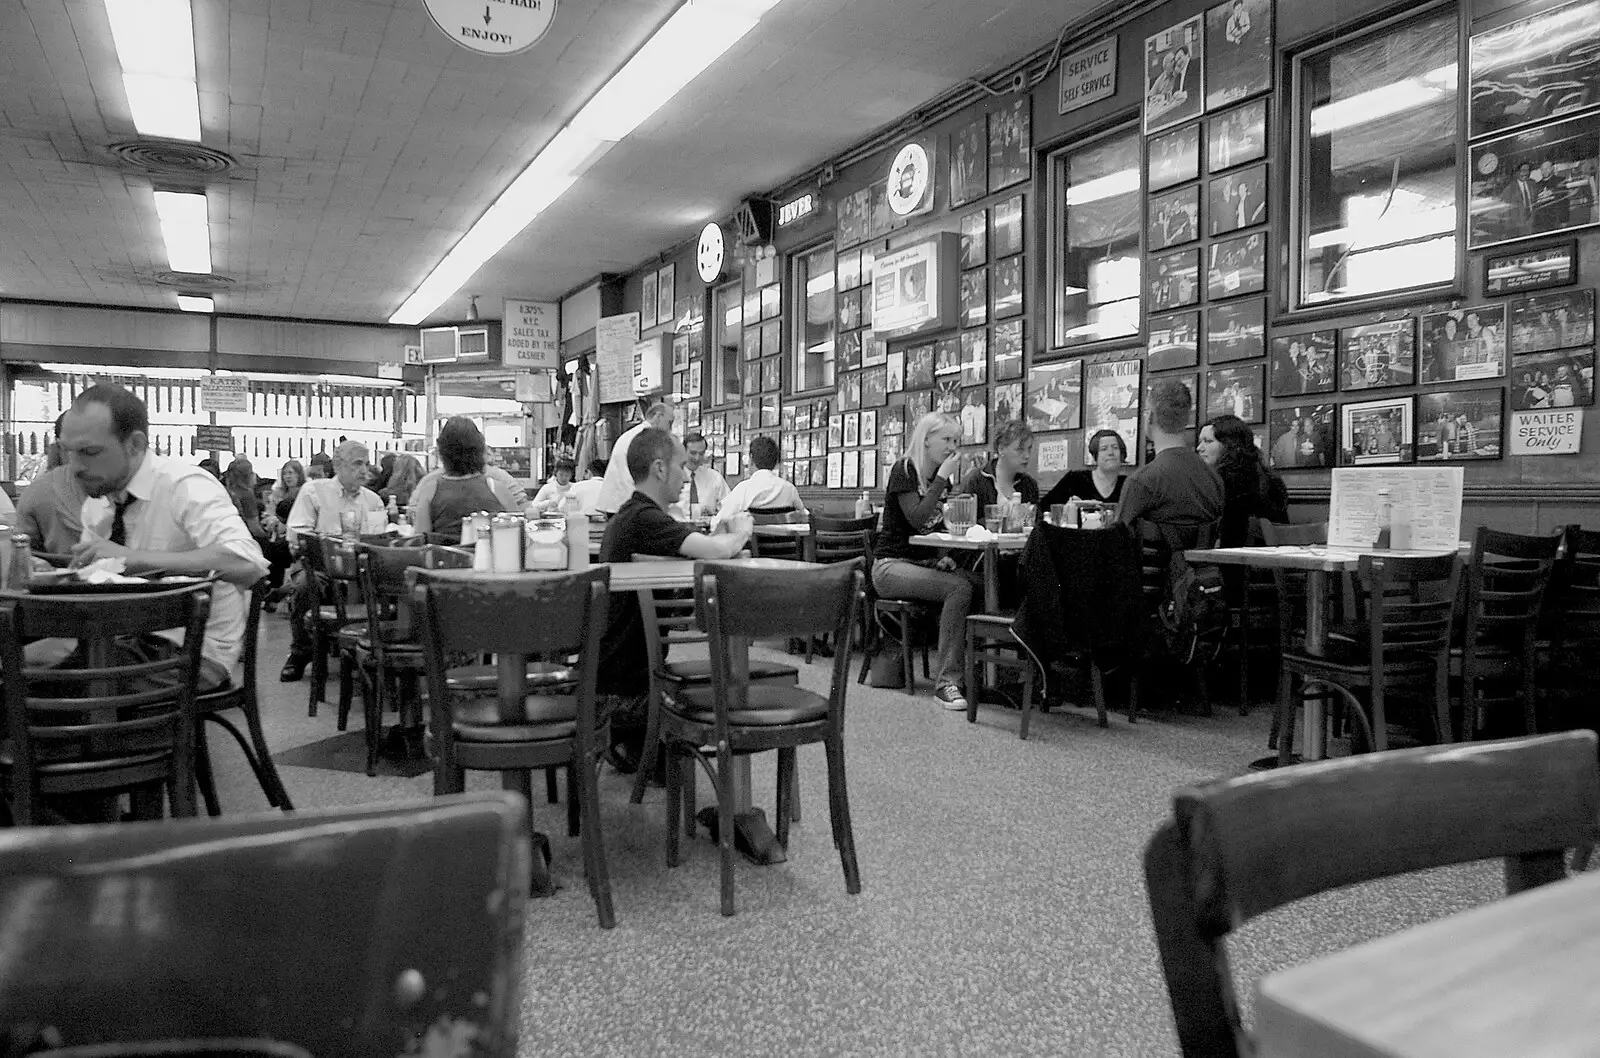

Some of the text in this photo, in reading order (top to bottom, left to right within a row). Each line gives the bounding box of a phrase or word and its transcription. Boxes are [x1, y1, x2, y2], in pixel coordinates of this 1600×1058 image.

[461, 26, 512, 45] ENJOY!
[1068, 49, 1109, 77] SERVICE
[1064, 73, 1111, 104] SELF SERVICE
[778, 194, 812, 225] JEVER
[513, 327, 550, 338] SALES TAX
[508, 338, 556, 350] ADDED BY THE
[517, 350, 546, 361] CASHIER
[1519, 413, 1575, 426] WAITER
[1518, 424, 1575, 438] SERVICE
[1526, 435, 1562, 450] Only
